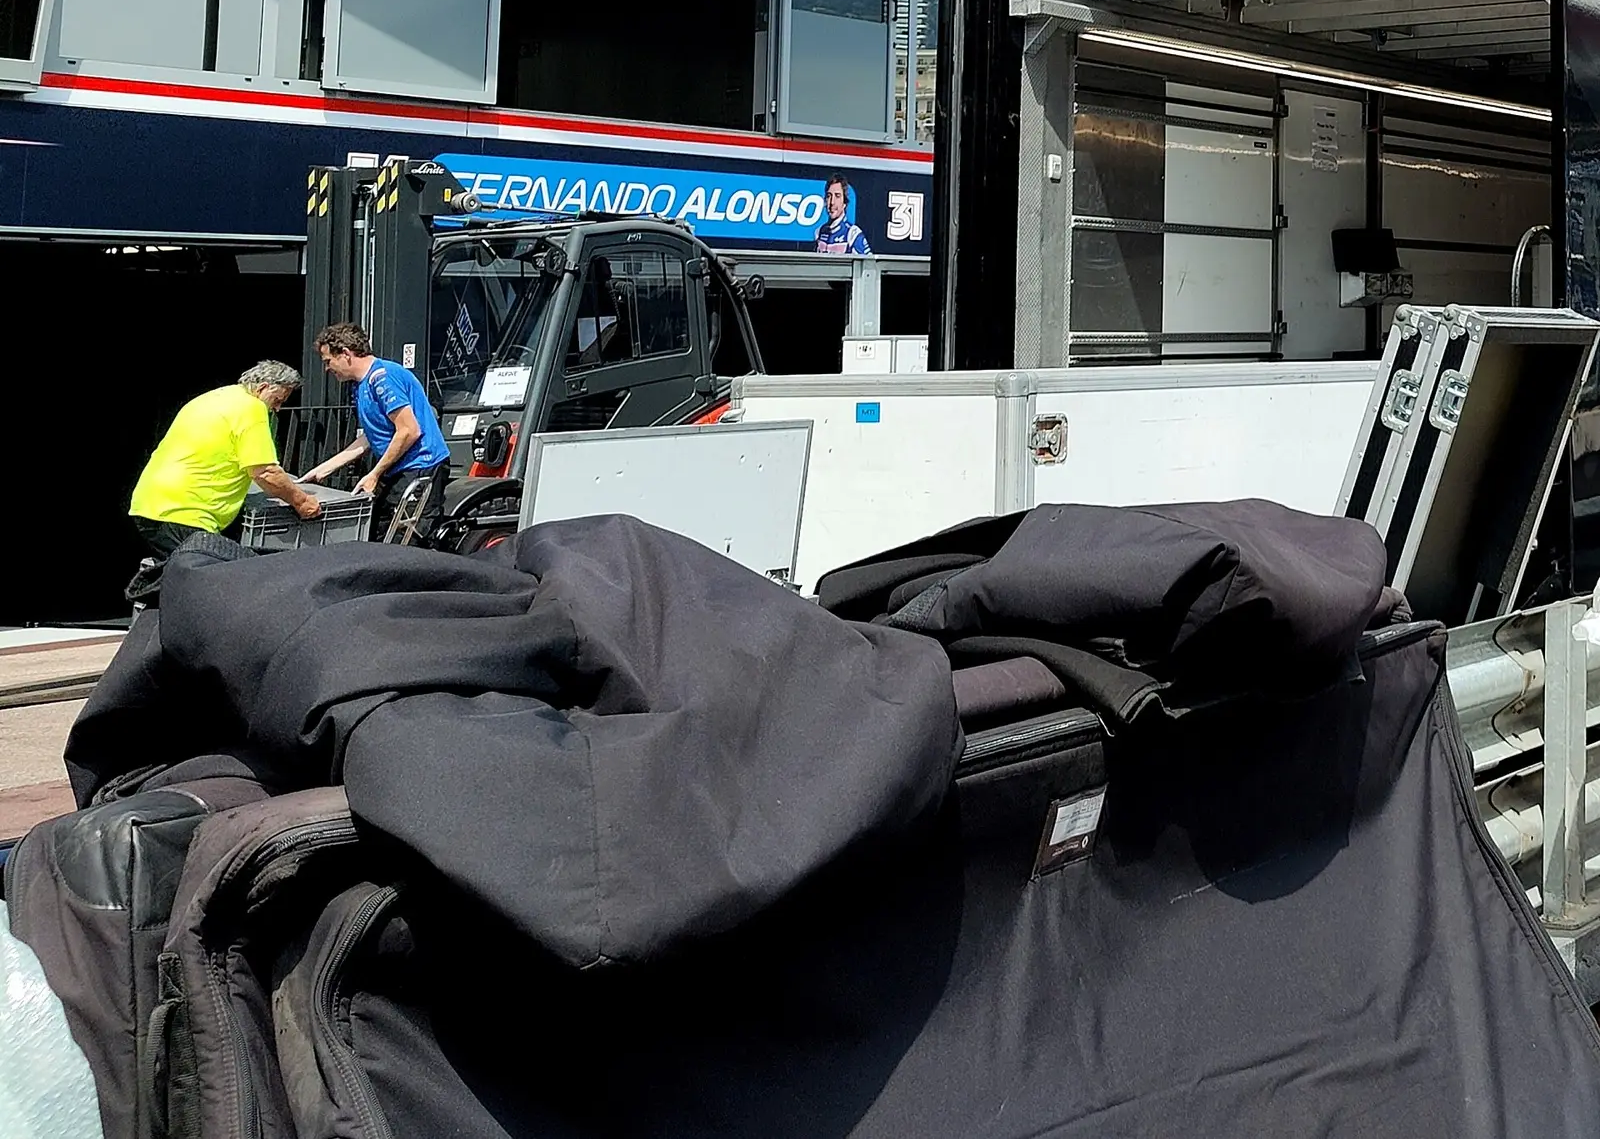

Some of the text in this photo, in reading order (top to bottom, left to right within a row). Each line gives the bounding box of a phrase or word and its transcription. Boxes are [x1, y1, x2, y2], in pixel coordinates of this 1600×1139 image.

[411, 163, 445, 175] Linde
[678, 187, 825, 227] ALONSO
[887, 191, 925, 241] 31
